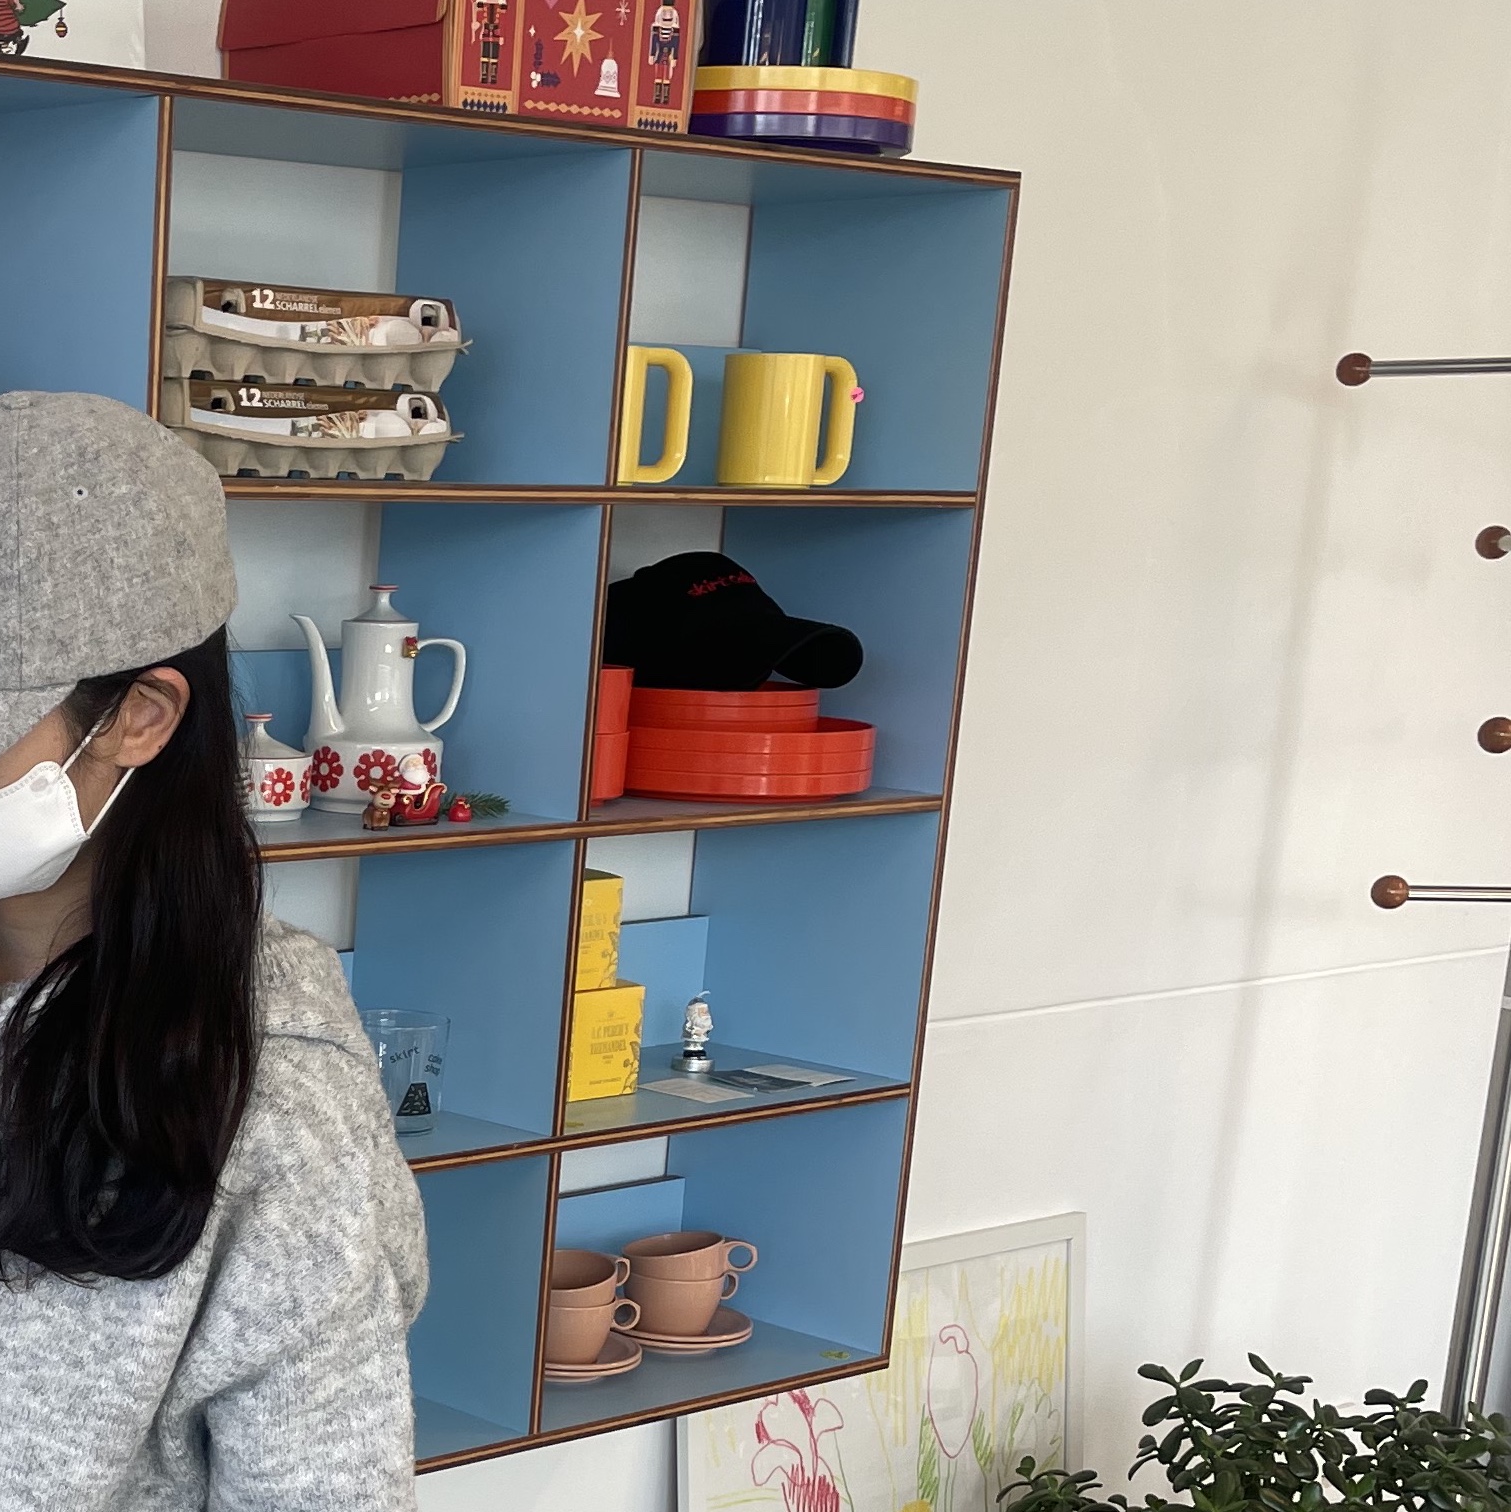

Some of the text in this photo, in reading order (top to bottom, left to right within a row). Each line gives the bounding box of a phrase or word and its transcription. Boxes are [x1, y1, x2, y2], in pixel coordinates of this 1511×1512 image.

[252, 288, 275, 309] 12
[238, 388, 263, 407] 12
[389, 1046, 420, 1064] skirt
